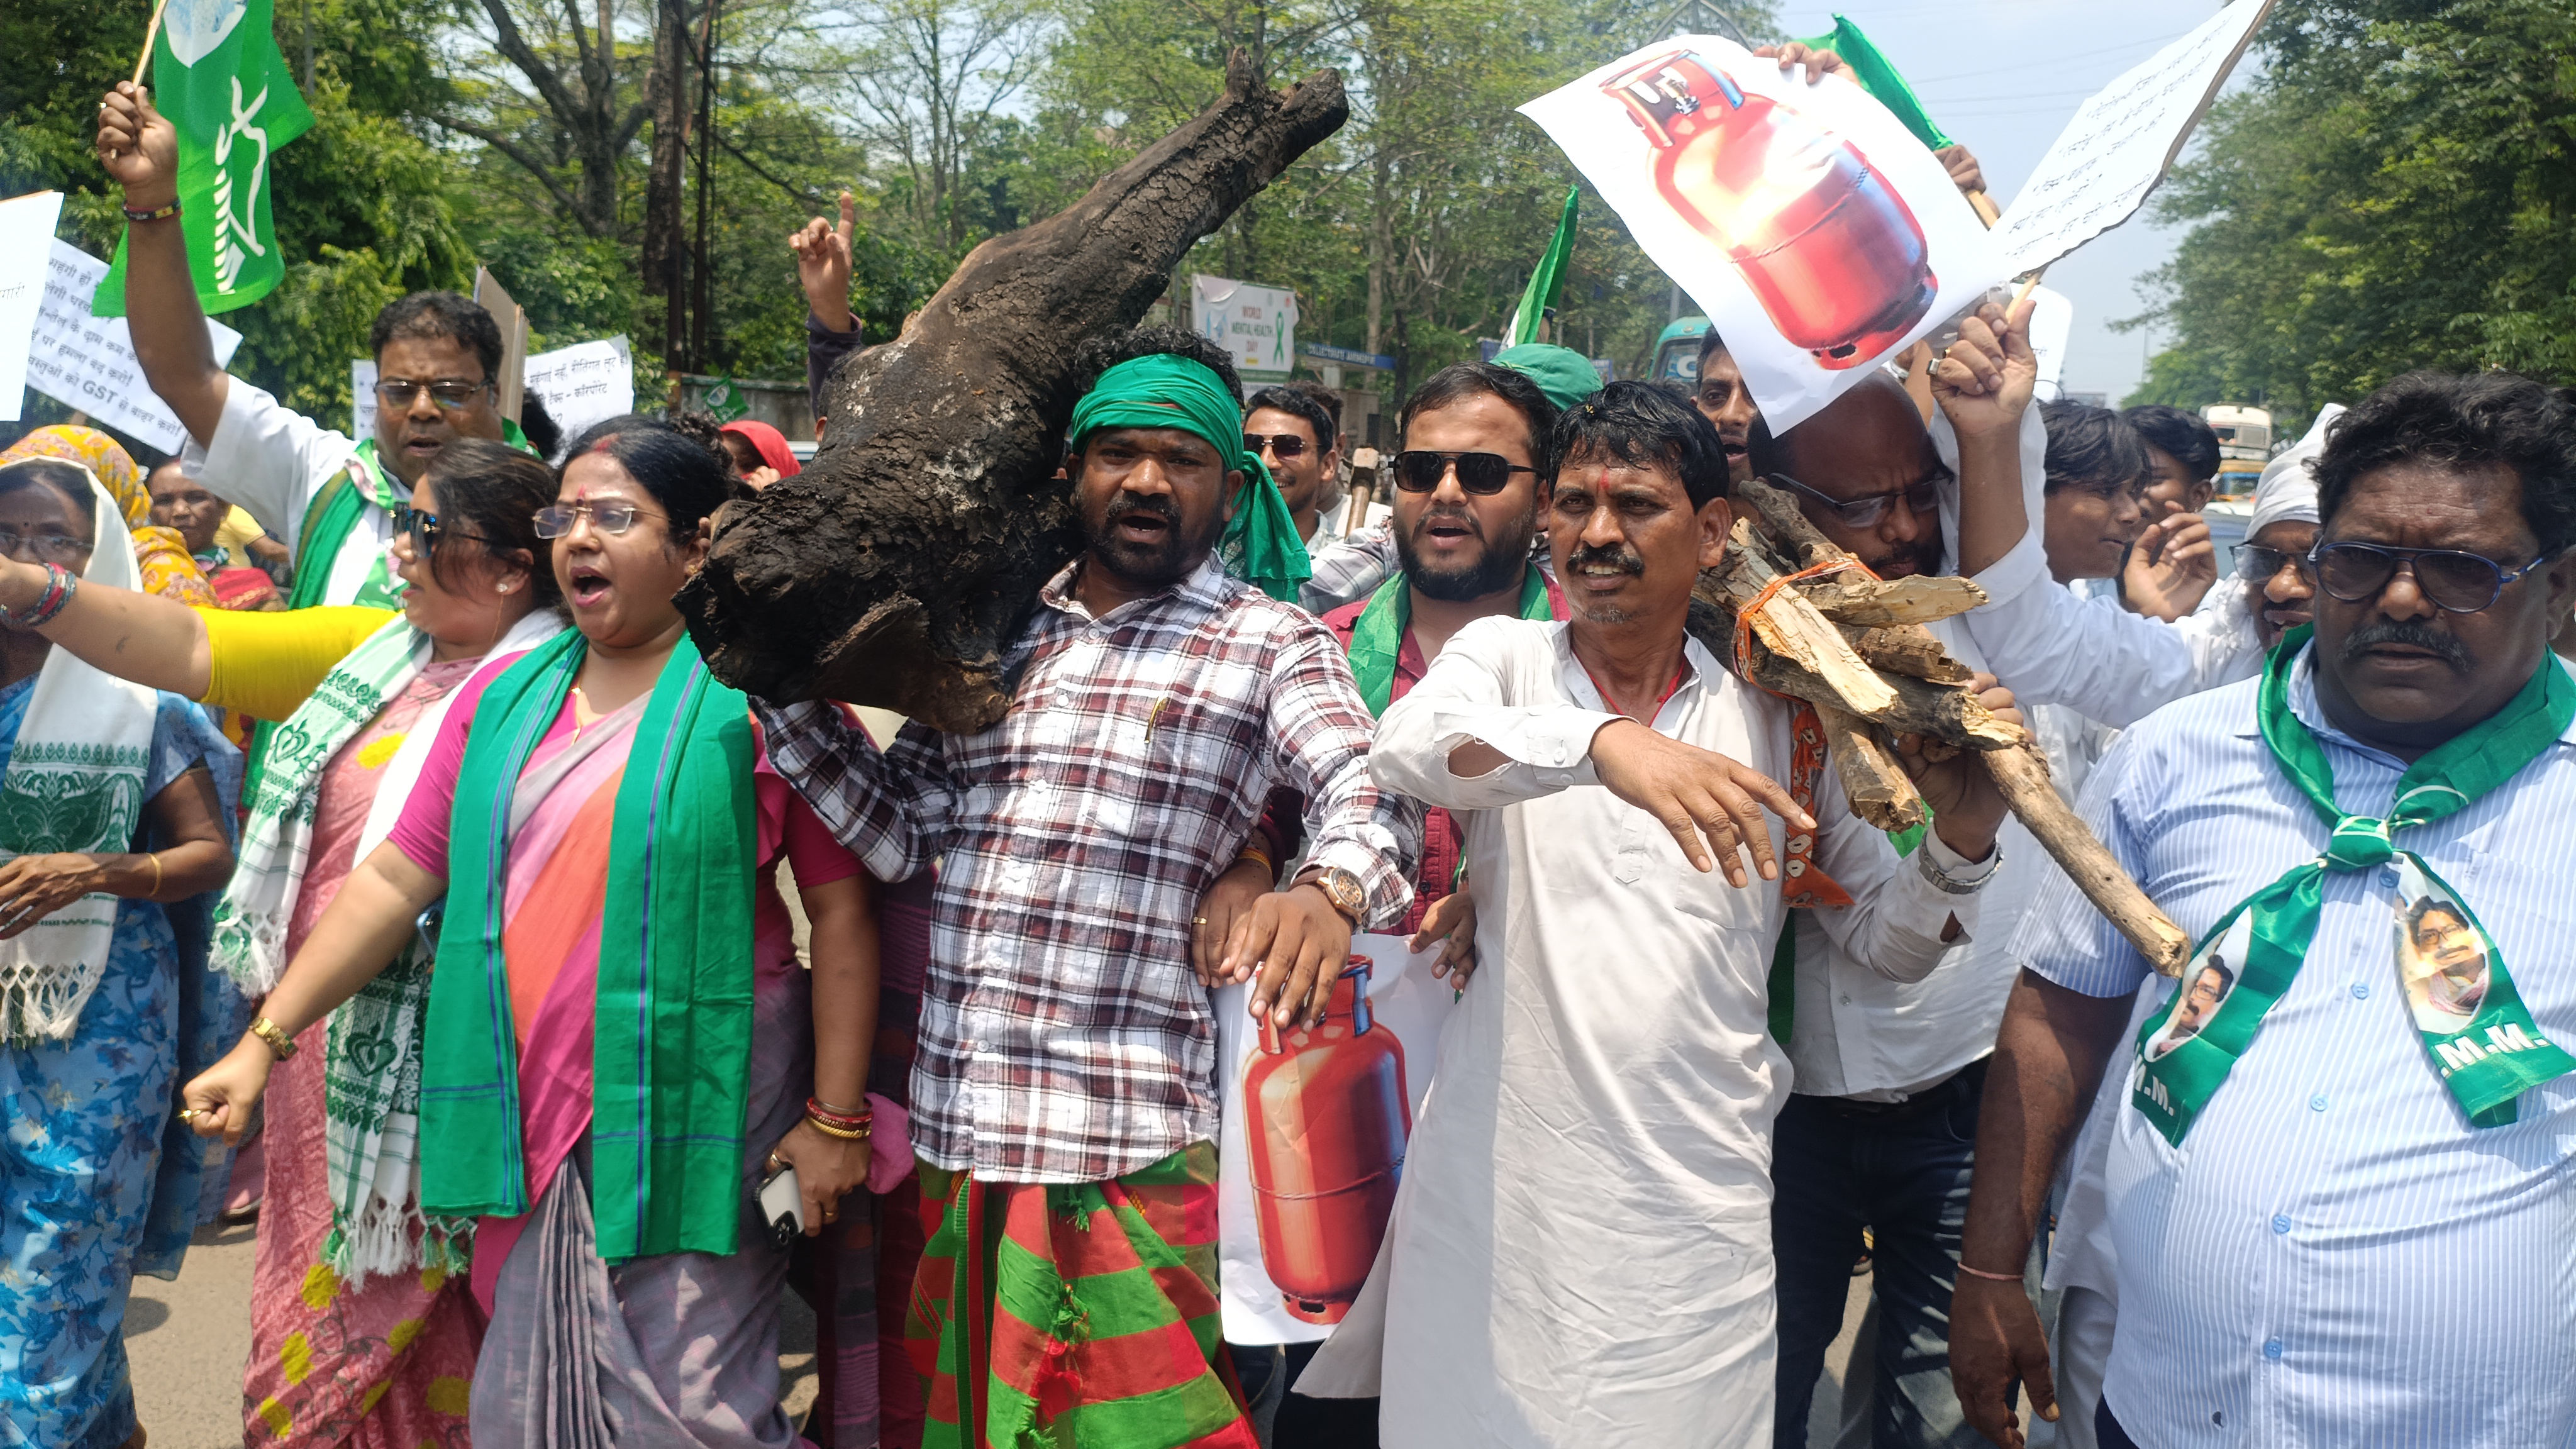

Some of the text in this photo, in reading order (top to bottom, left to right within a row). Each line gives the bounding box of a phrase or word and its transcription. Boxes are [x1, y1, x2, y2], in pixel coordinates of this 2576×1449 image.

[1241, 306, 1262, 319] WORLD
[1231, 321, 1274, 338] MENTAL HEALTH
[43, 335, 56, 348] पर
[1246, 340, 1259, 353] DAY
[82, 380, 118, 404] GST
[2434, 1023, 2548, 1078] .M.M.
